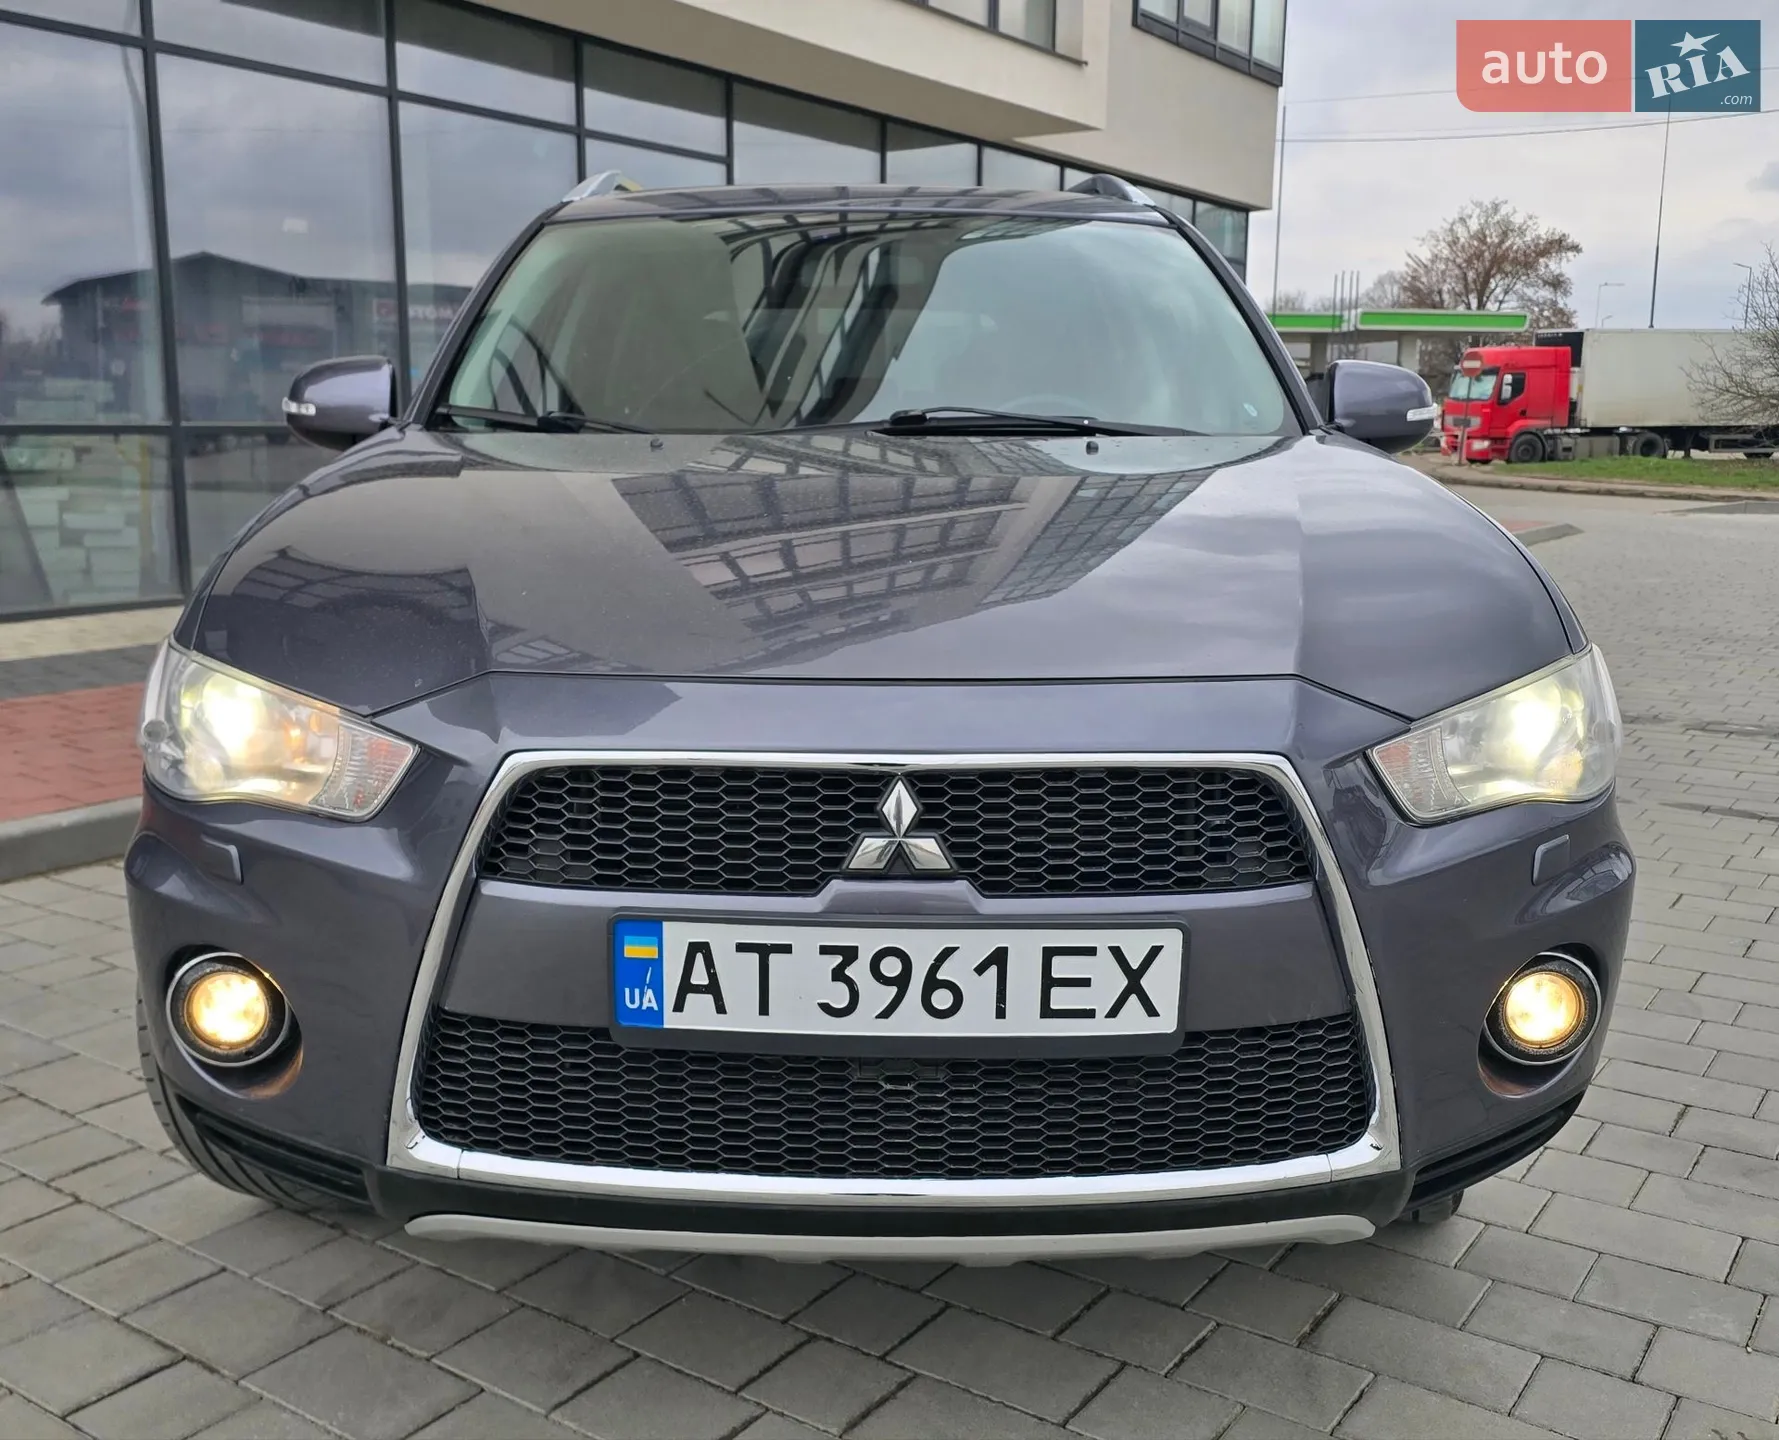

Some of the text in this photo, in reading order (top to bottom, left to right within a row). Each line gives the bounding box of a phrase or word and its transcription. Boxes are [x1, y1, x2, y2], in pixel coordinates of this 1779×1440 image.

[624, 987, 659, 1011] UA
[672, 940, 1165, 1020] AT 3961 EX
